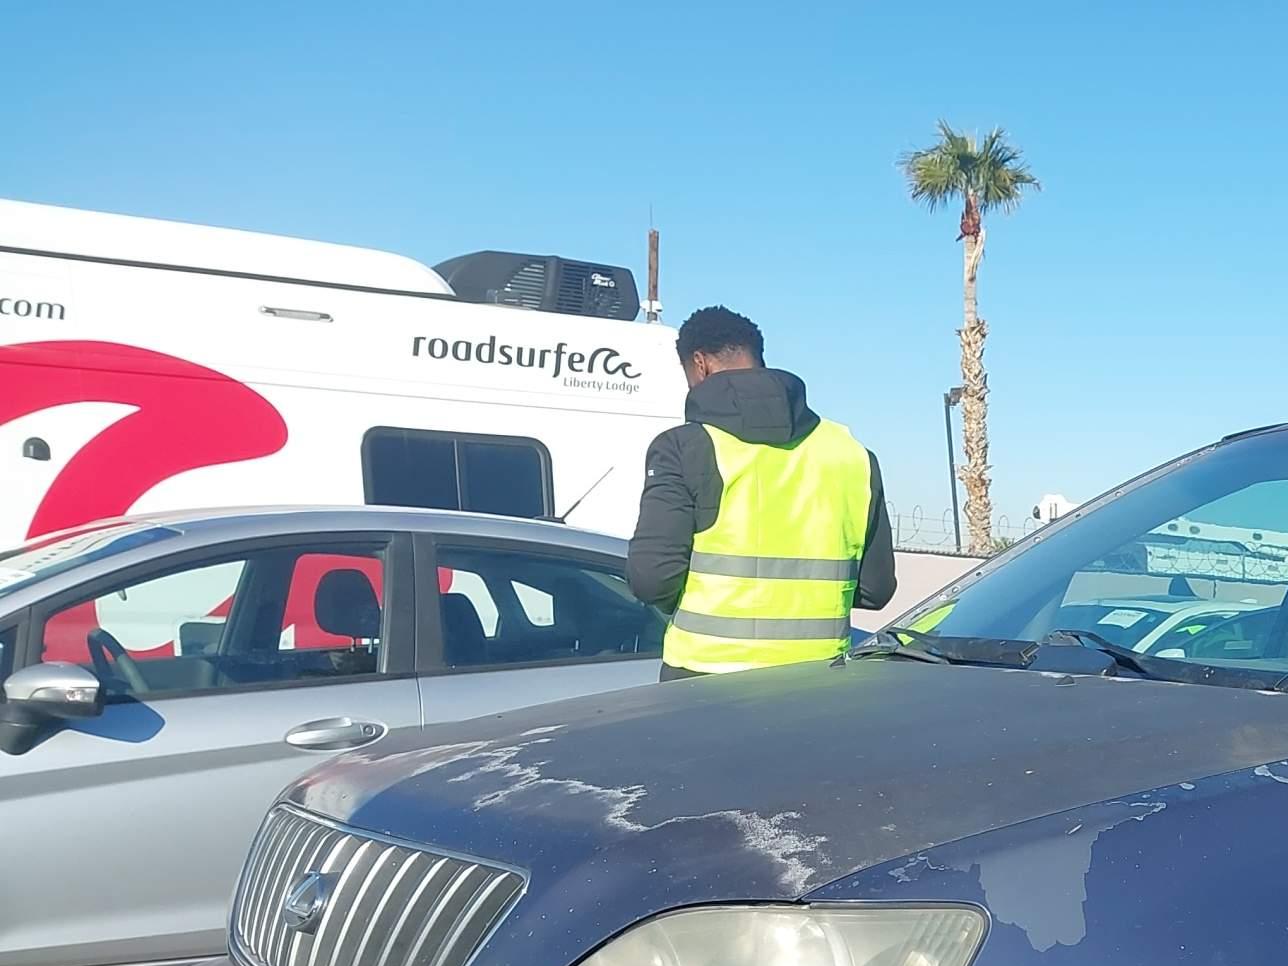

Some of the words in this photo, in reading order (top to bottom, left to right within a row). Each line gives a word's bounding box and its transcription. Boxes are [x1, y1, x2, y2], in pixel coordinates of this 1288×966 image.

[412, 335, 642, 379] roadsurfer
[563, 377, 603, 392] Liberty
[606, 381, 640, 394] Lodge
